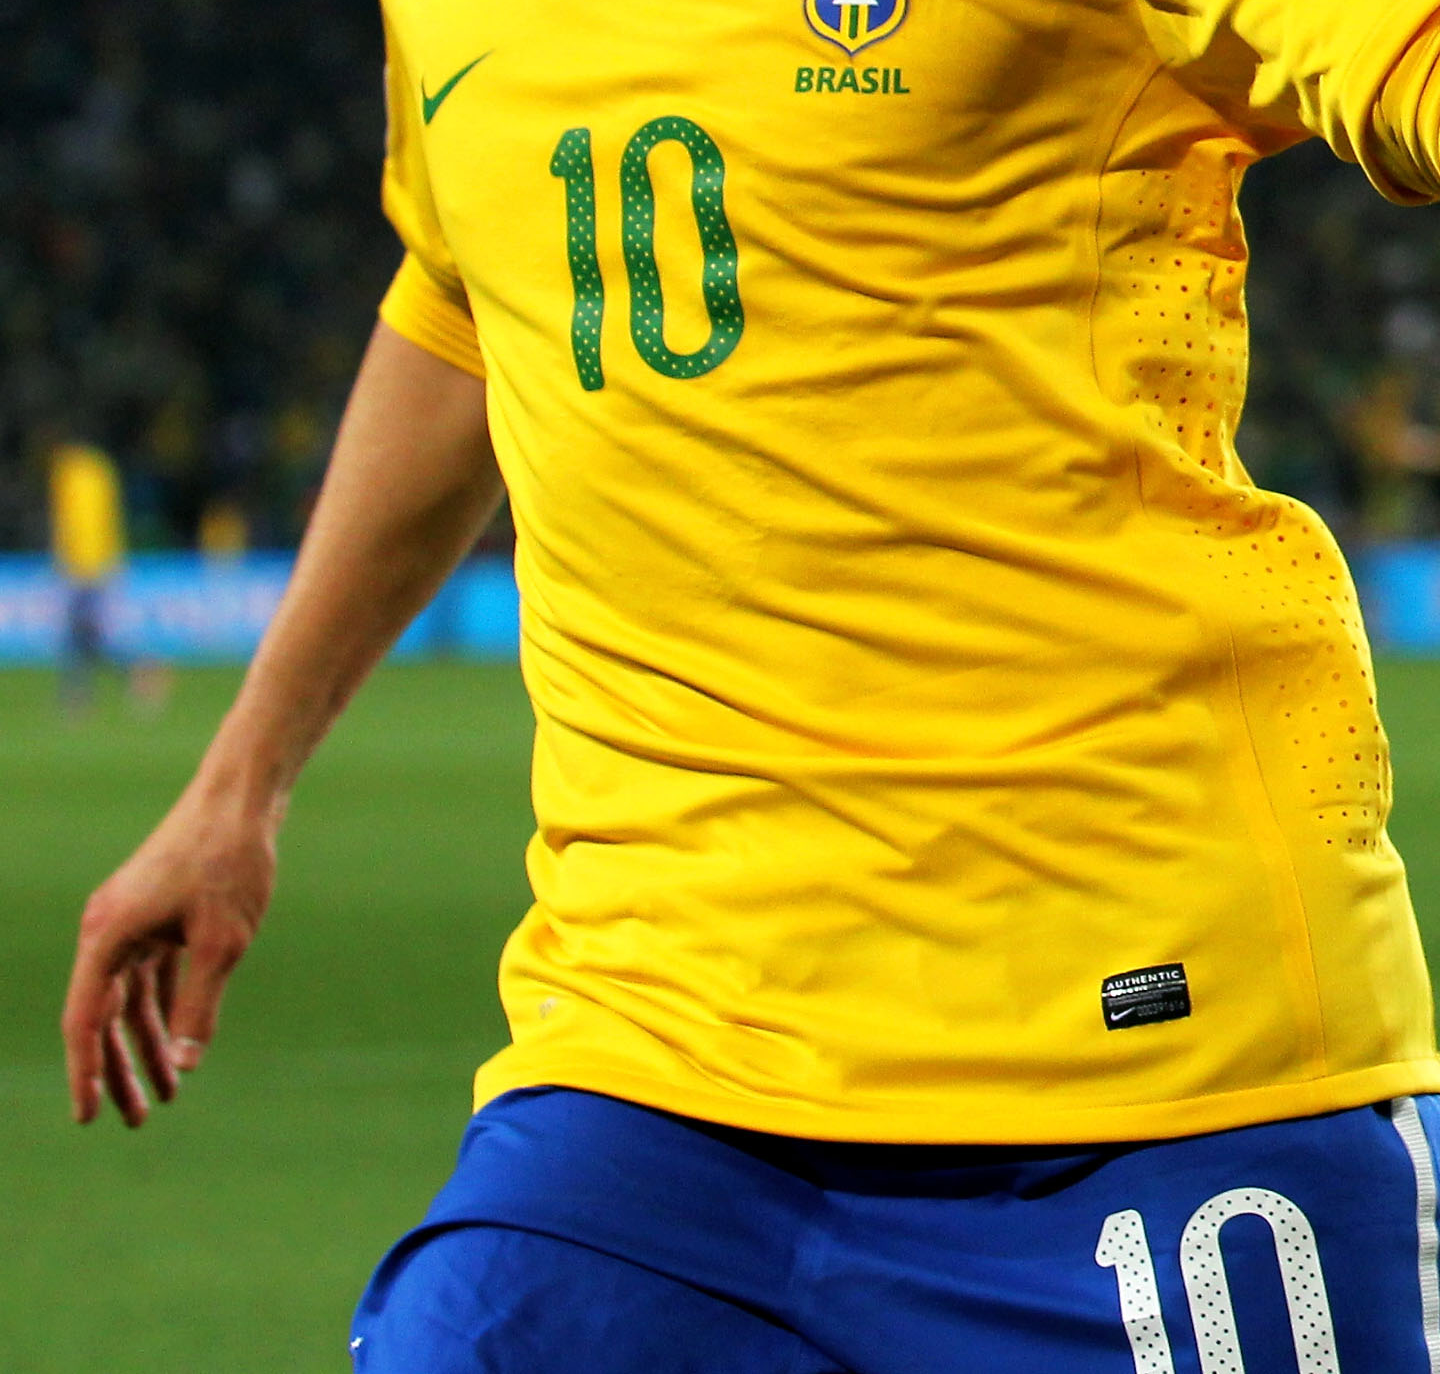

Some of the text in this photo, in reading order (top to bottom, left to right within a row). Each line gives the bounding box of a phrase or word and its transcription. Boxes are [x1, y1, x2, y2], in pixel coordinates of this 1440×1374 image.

[795, 67, 911, 95] BRASIL
[550, 115, 745, 391] 10
[1106, 970, 1180, 990] AUTHENTIC
[1095, 1187, 1341, 1374] 10
